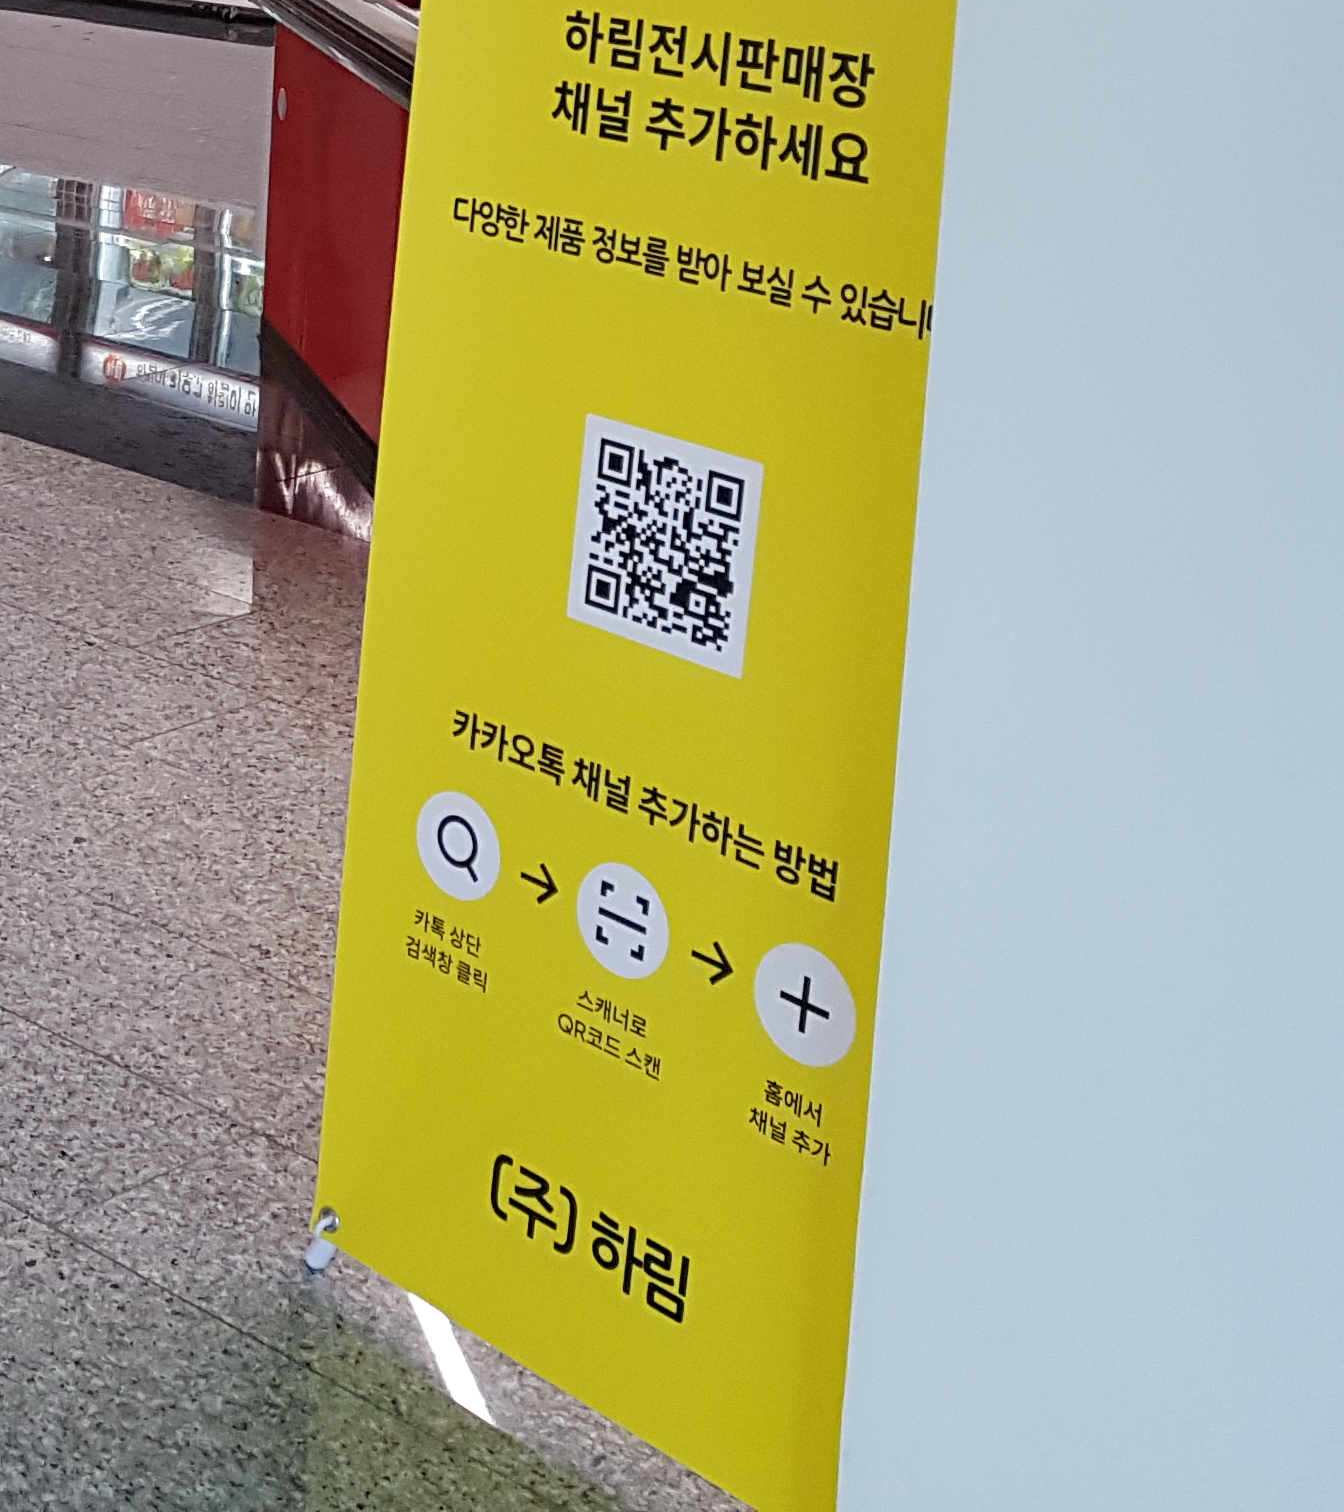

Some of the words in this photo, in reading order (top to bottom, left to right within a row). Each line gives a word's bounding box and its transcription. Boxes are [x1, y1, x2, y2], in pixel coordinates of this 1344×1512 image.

[565, 9, 876, 109] 하림전시판매장
[551, 80, 632, 143] 채널
[645, 97, 869, 185] 추가하세요
[453, 197, 530, 244] 다양한
[533, 214, 586, 257] 제품
[592, 226, 670, 278] 정보를
[676, 244, 733, 292] 받아
[736, 261, 795, 308] 보실
[801, 275, 832, 314] 수
[840, 283, 933, 340] 있습니
[452, 709, 566, 787] 카카오톡
[571, 757, 631, 815] 채널
[637, 786, 765, 870] 추가하는
[773, 839, 839, 903] 방법
[405, 935, 454, 975] 검색창
[456, 960, 488, 994] 클릭
[414, 909, 446, 941] 카톡
[449, 926, 482, 959] 상단
[557, 1013, 621, 1059] QR코드
[624, 1047, 661, 1082] 스캔
[576, 990, 647, 1038] 스캐너로
[748, 1107, 787, 1145] 채널
[791, 1129, 831, 1167] 추가
[763, 1079, 823, 1128] 홈에서
[490, 1154, 578, 1255] (주)
[591, 1211, 690, 1324] 하림
